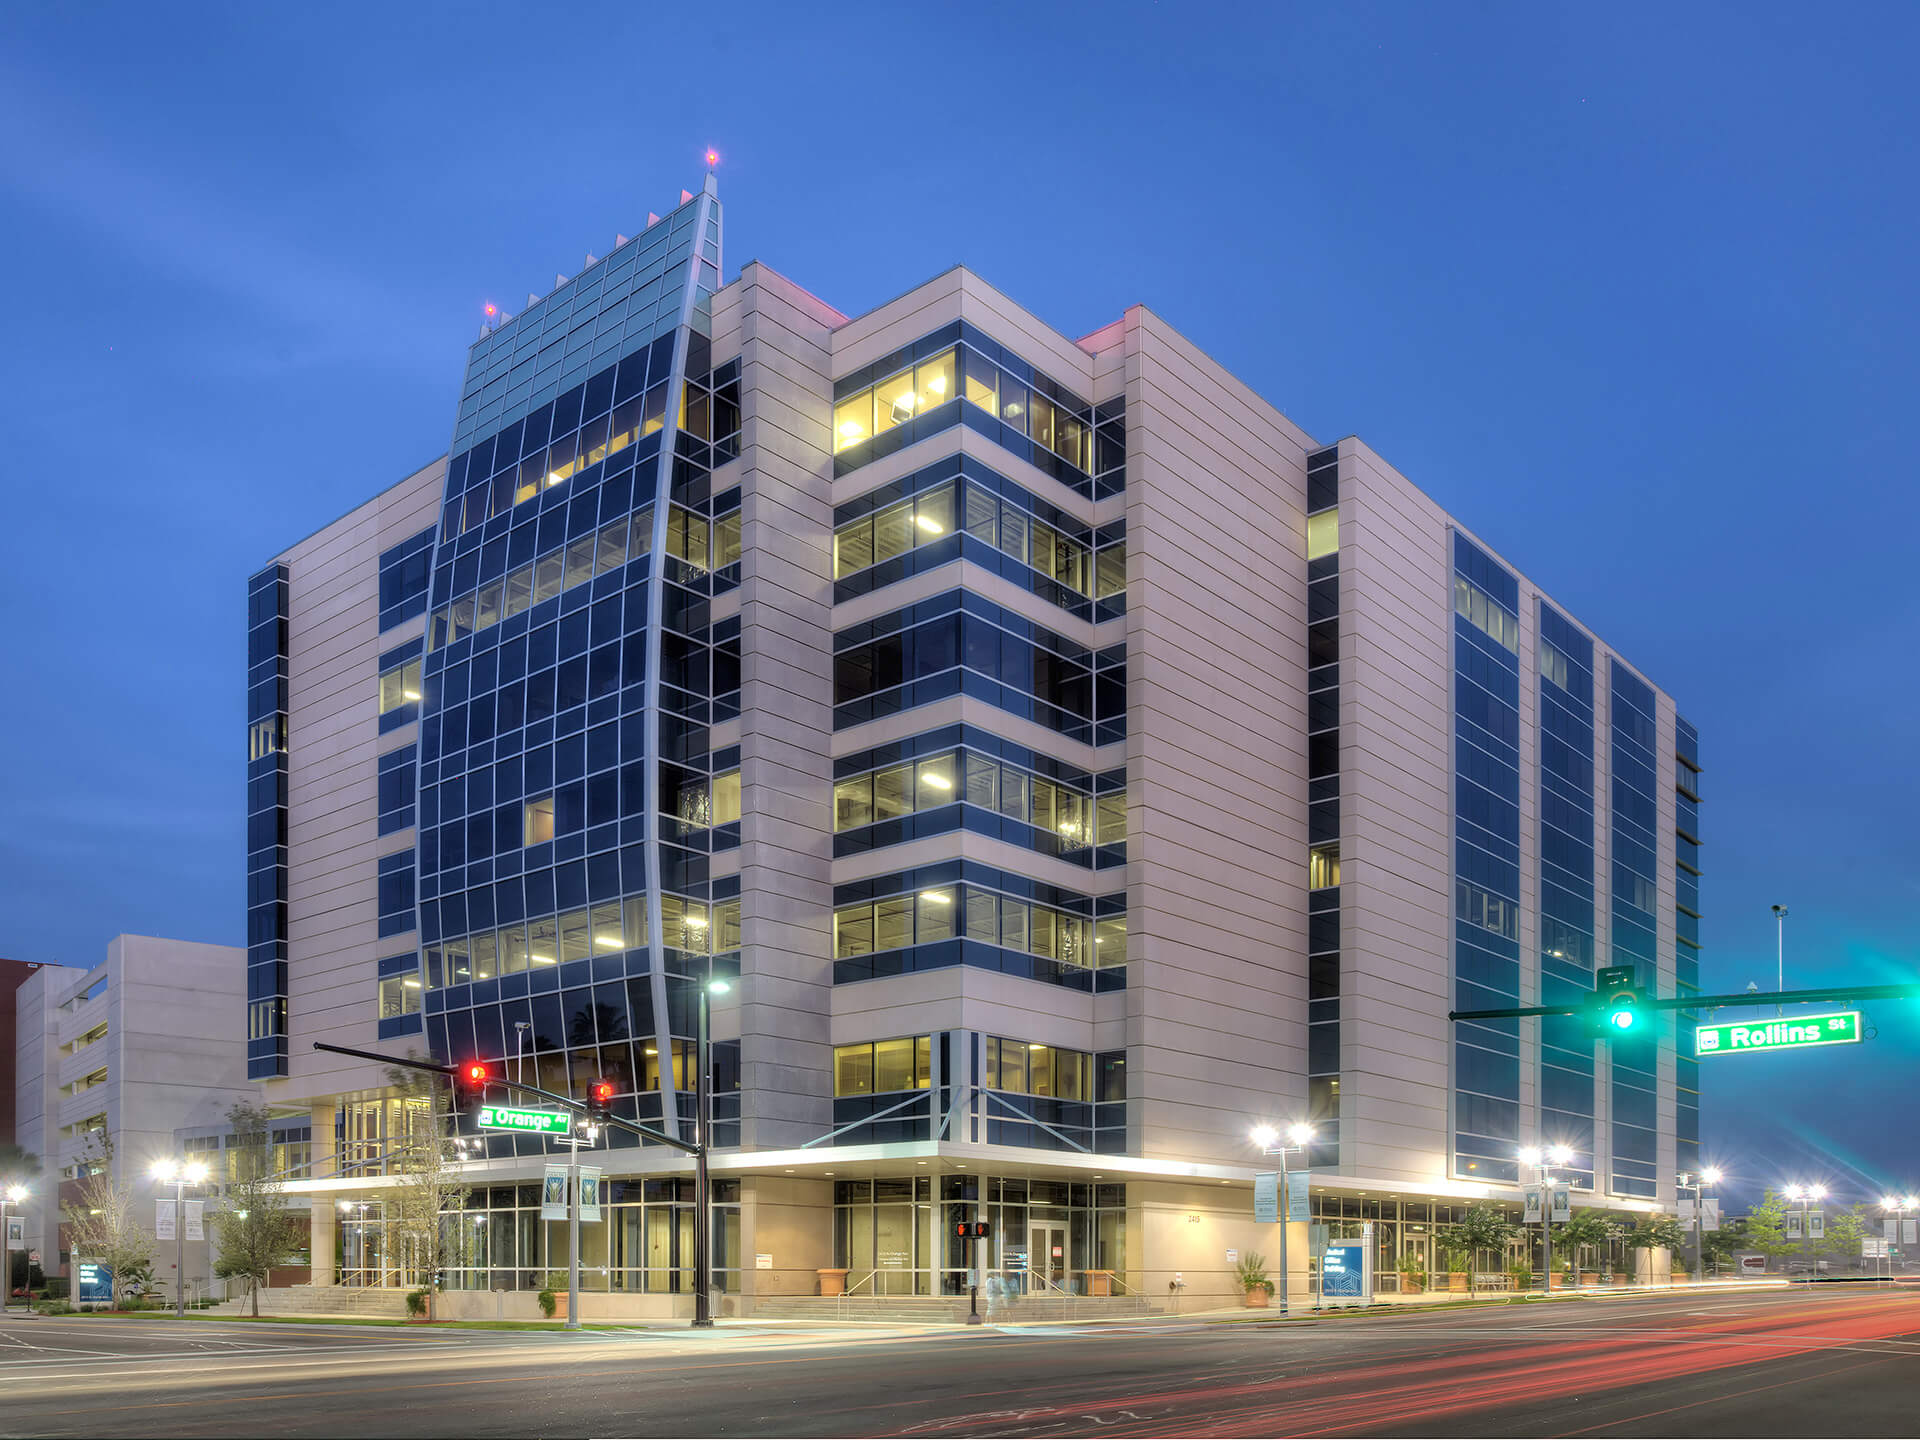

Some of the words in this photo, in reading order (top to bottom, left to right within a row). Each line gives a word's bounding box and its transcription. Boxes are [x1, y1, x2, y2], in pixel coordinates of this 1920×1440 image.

[1730, 1023, 1821, 1047] Rollins
[1828, 1018, 1846, 1030] St
[496, 1110, 551, 1130] Orange
[554, 1114, 567, 1123] Av
